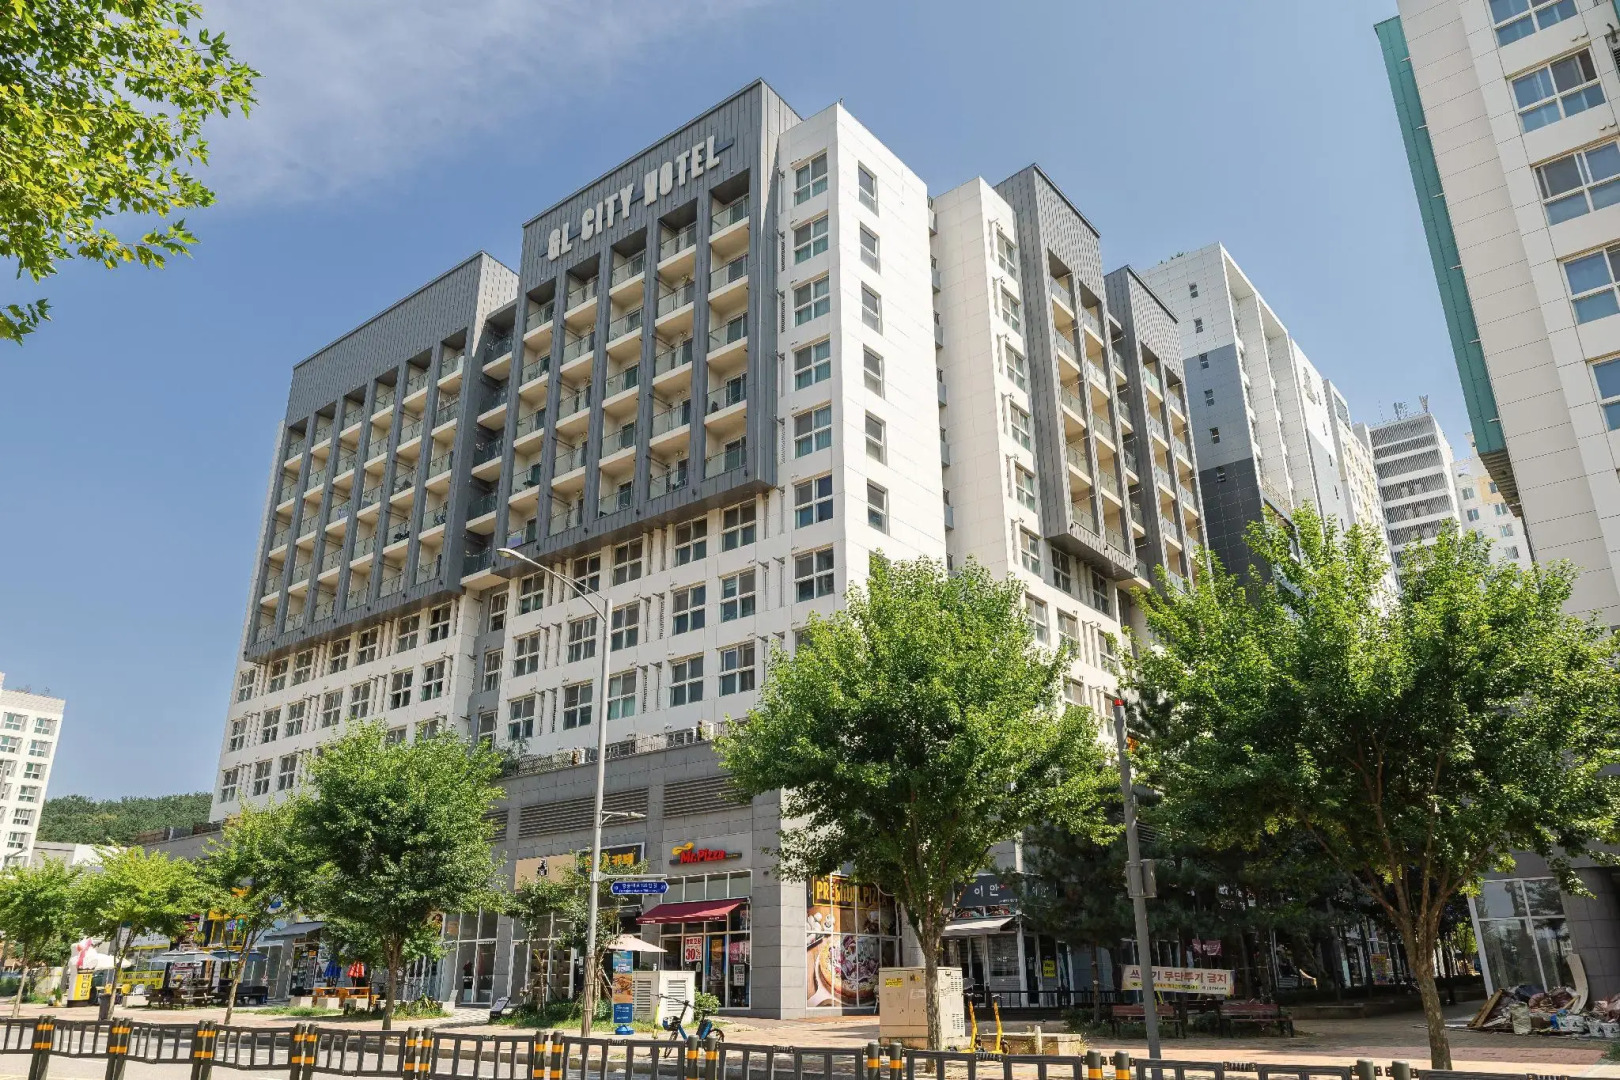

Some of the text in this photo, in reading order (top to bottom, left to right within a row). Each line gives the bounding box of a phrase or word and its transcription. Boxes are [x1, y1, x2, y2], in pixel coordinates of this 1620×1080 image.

[547, 135, 720, 261] GL CITY HOTEL
[1130, 969, 1227, 985] 쓰기 무단투기 금지
